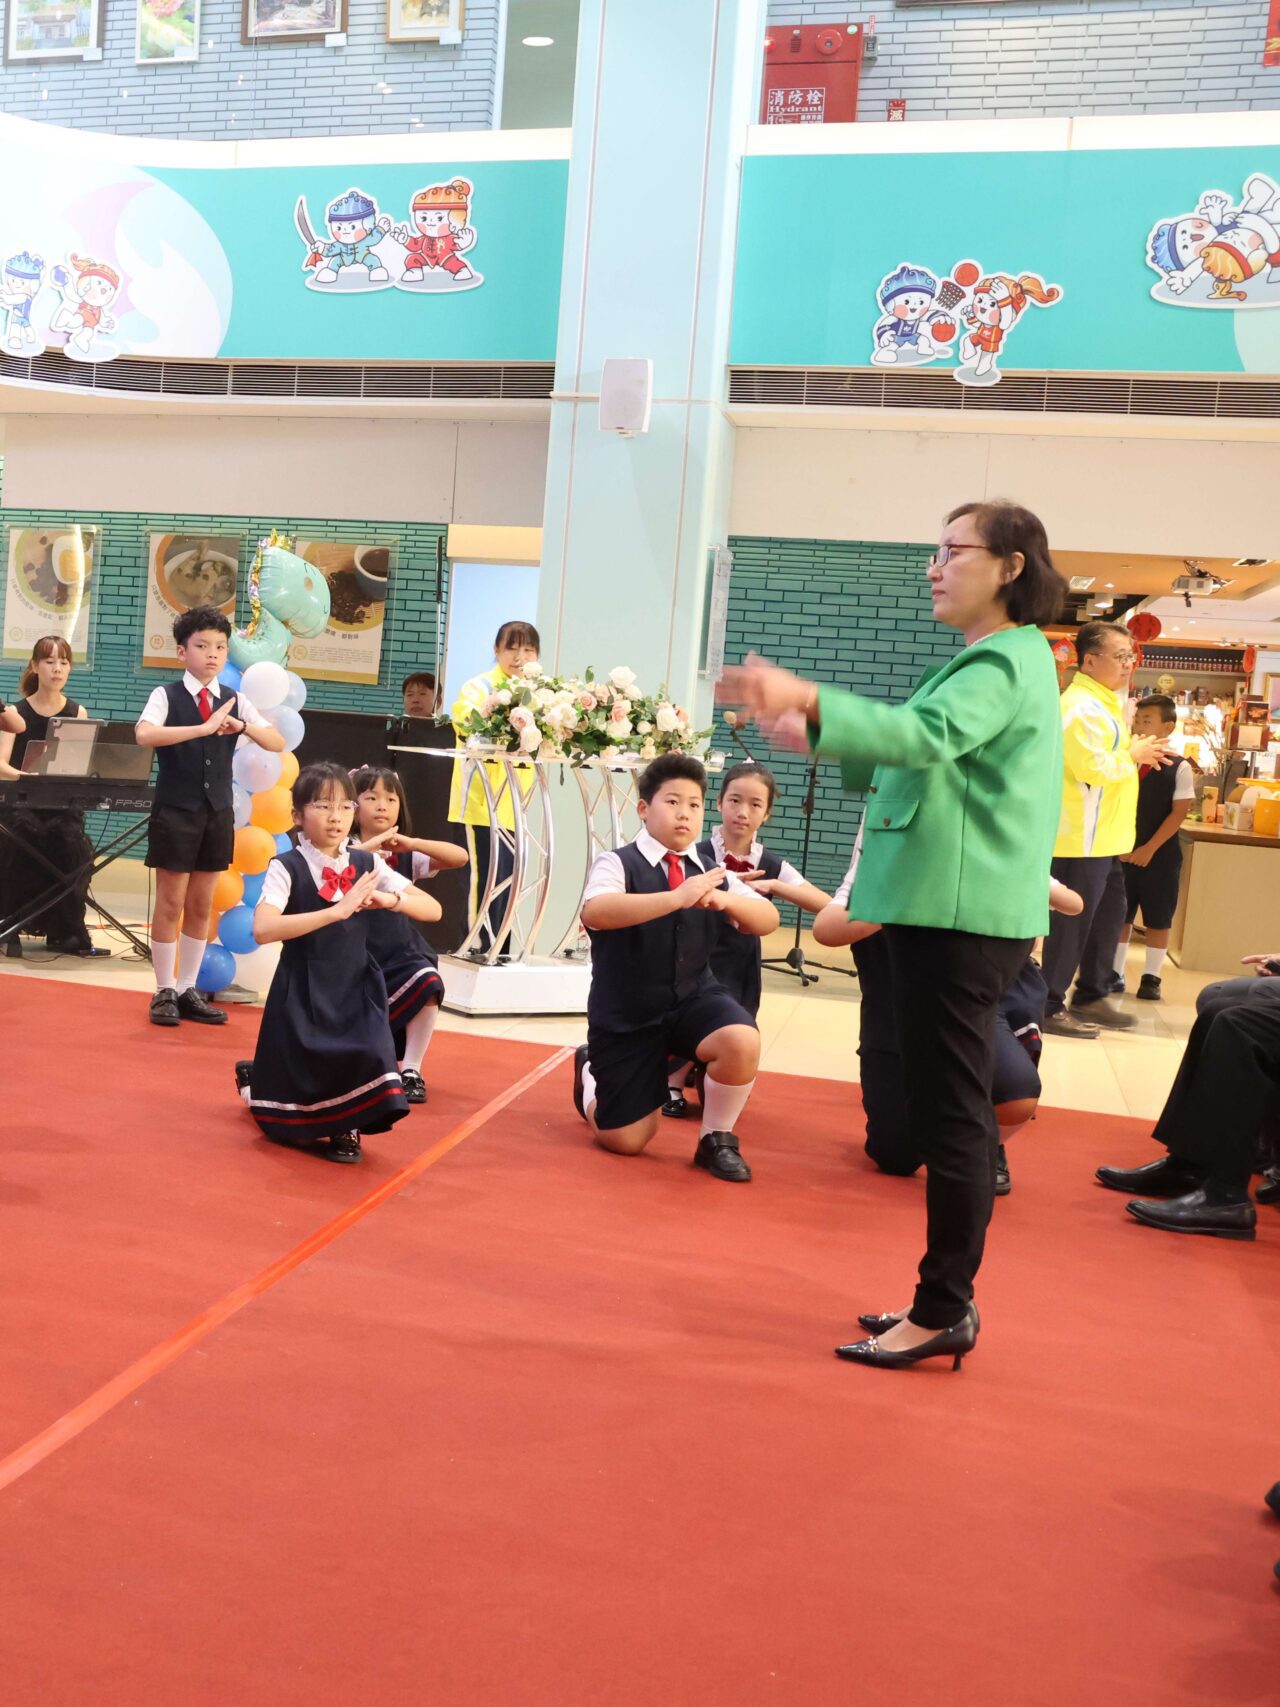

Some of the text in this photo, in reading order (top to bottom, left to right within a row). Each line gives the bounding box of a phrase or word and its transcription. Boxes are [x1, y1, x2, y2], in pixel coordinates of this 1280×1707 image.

[769, 89, 823, 106] 消防栓
[769, 105, 823, 114] Hydrant
[115, 799, 153, 808] FP-50
